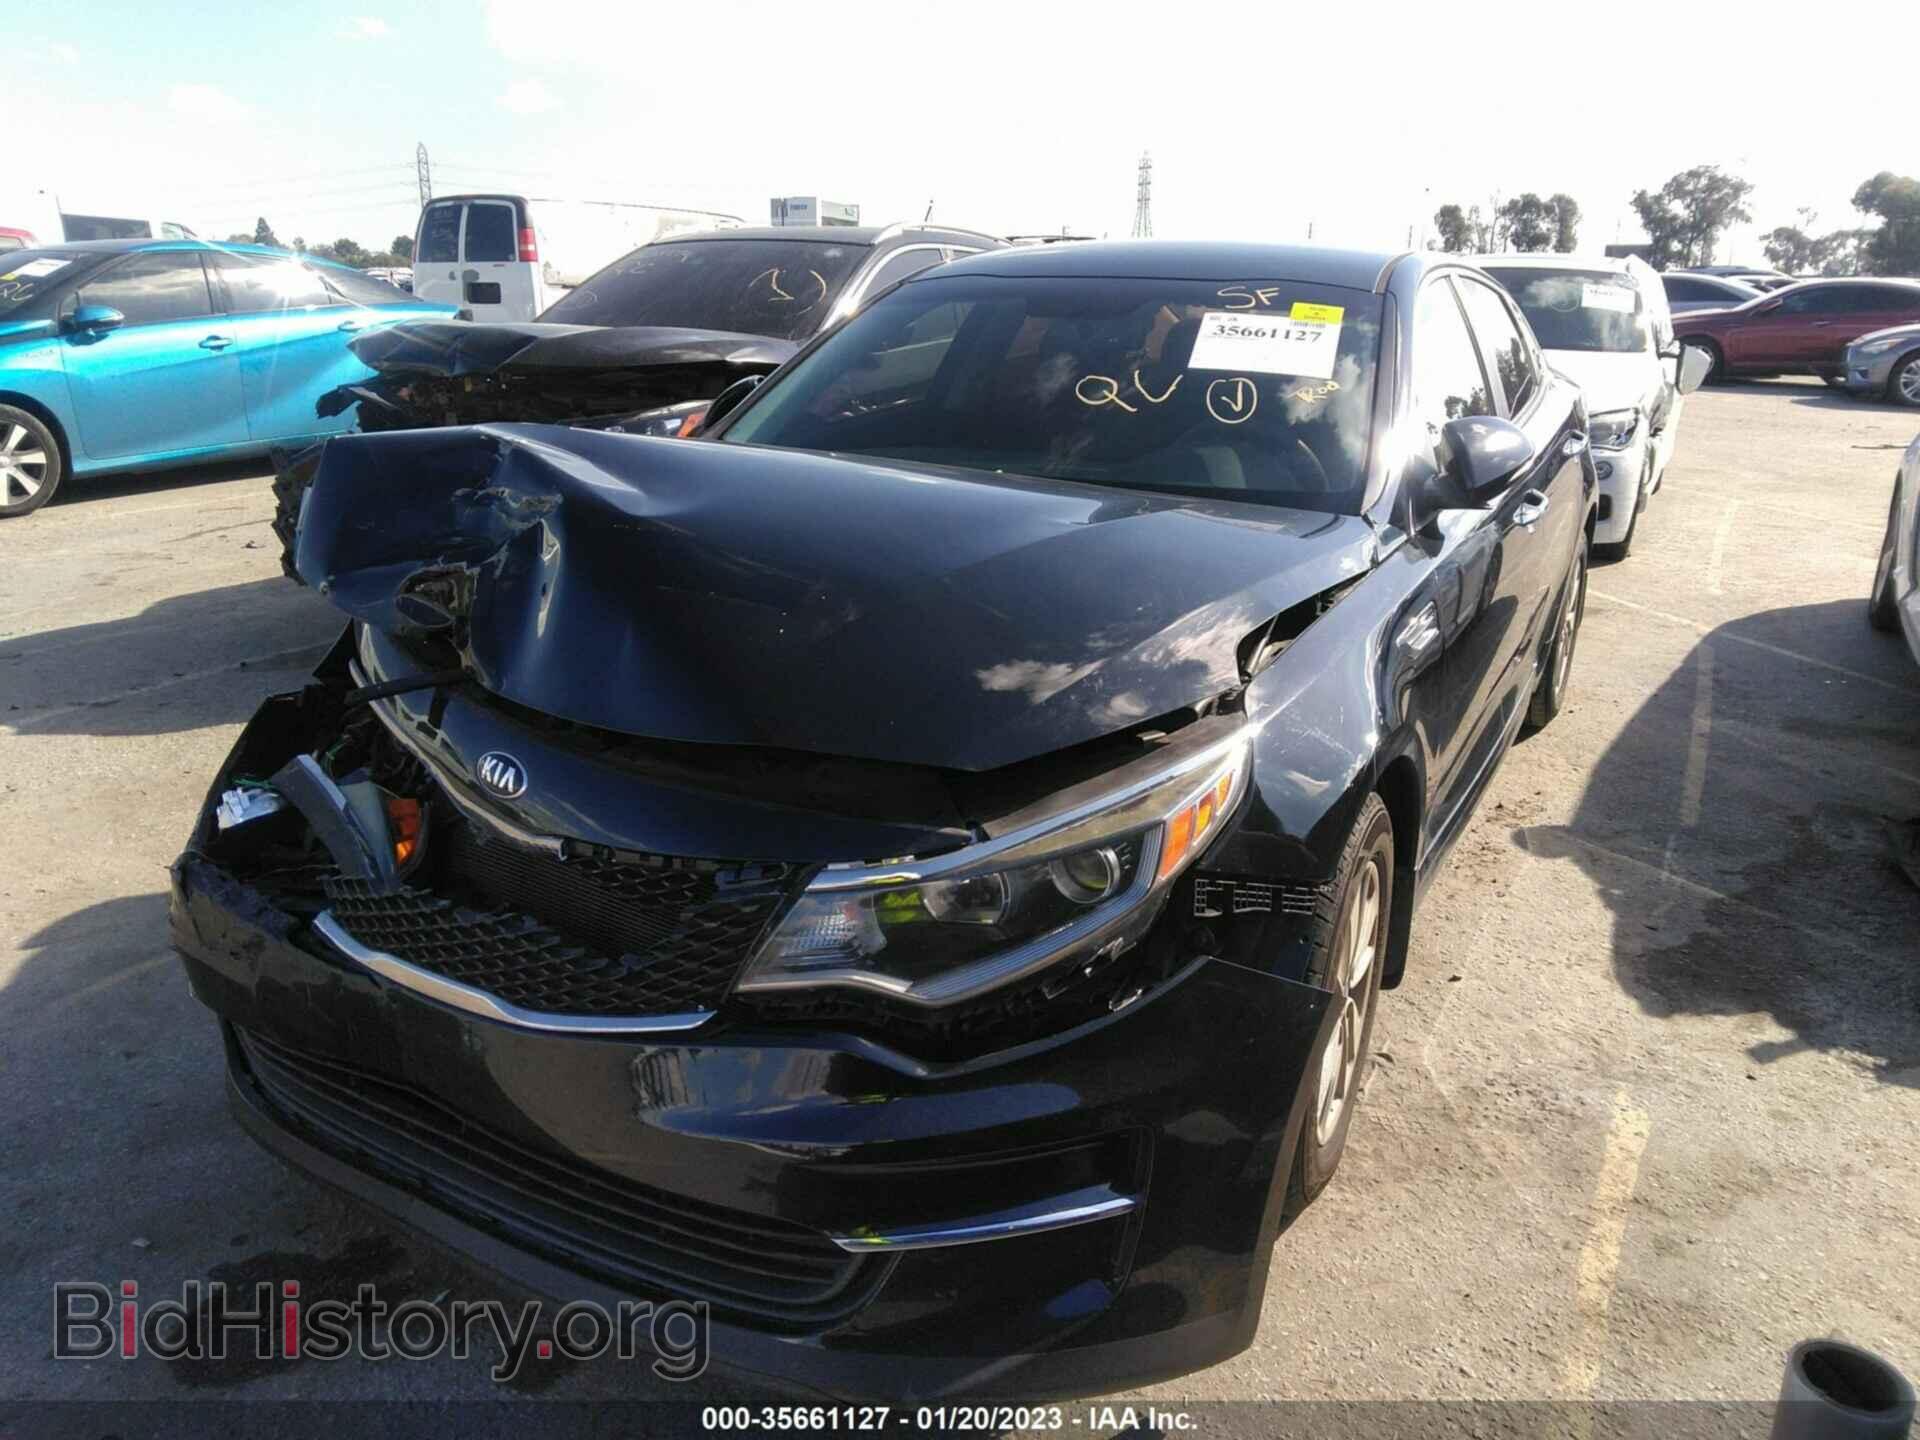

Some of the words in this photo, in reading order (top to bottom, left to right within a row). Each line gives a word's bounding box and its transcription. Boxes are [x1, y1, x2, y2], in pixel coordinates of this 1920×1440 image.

[1216, 285, 1280, 310] SF
[1211, 324, 1323, 344] 35661127
[481, 755, 516, 793] KIA
